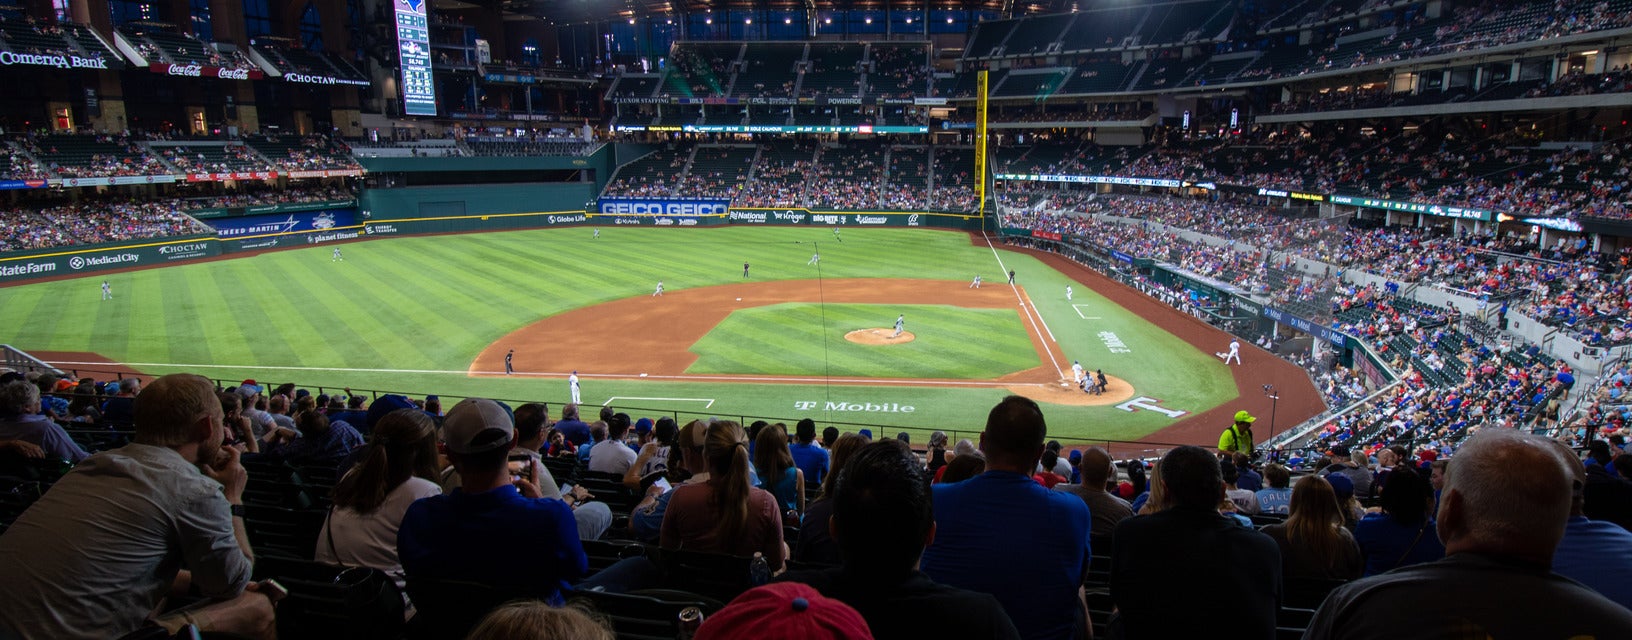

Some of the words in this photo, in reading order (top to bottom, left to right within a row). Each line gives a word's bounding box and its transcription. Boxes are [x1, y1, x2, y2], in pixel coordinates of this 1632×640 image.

[71, 56, 107, 69] Bank
[291, 73, 336, 85] CHOCTAW
[602, 203, 662, 215] GEICO
[667, 203, 727, 215] GEICO
[575, 214, 586, 222] Life
[738, 211, 767, 220] National
[783, 210, 805, 224] Kroger
[249, 224, 279, 233] MARTIN
[314, 234, 336, 243] planet
[336, 231, 358, 239] fitness
[165, 243, 207, 253] CHOCTAW
[86, 253, 121, 266] Medical
[121, 253, 139, 263] City
[823, 401, 915, 413] Mobile
